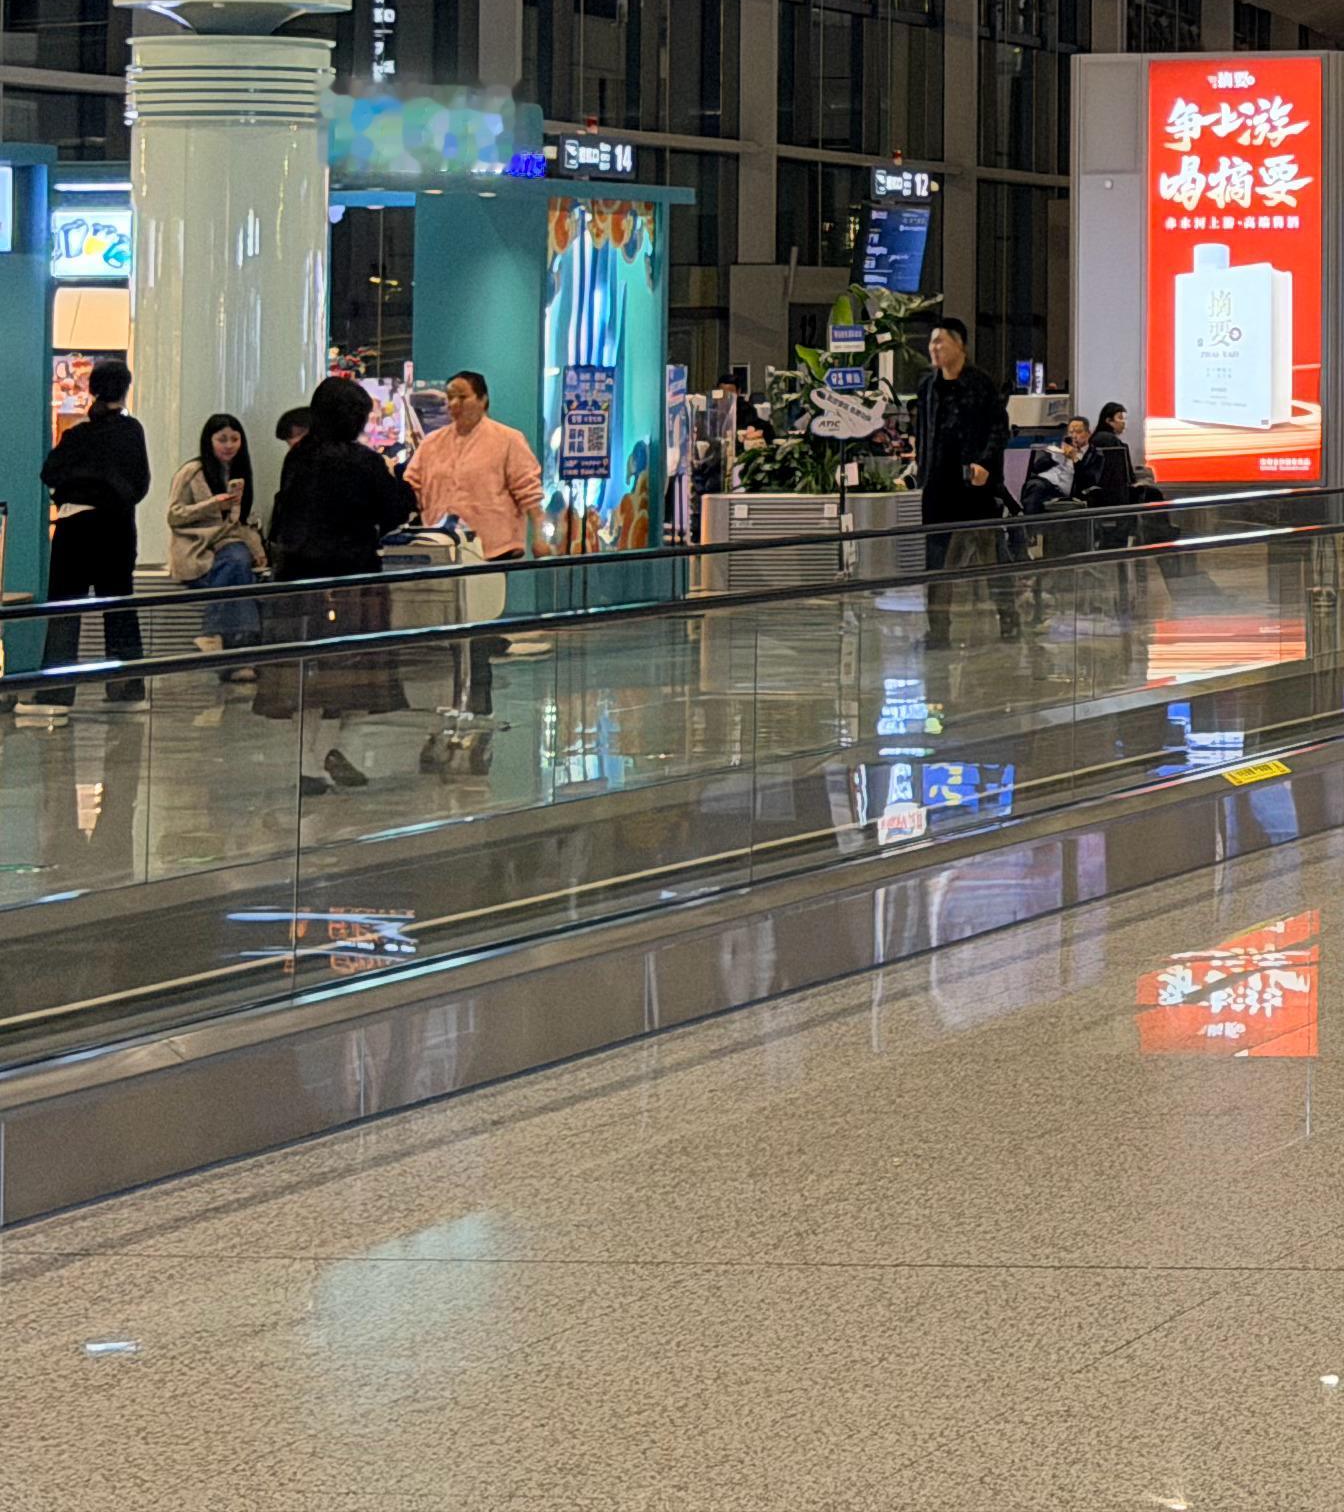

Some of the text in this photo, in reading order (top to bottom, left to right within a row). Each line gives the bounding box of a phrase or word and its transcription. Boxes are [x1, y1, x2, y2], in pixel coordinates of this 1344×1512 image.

[1163, 95, 1310, 152] 争上游
[614, 144, 632, 172] 14
[914, 173, 929, 197] 12
[1159, 154, 1314, 211] 喝摘要
